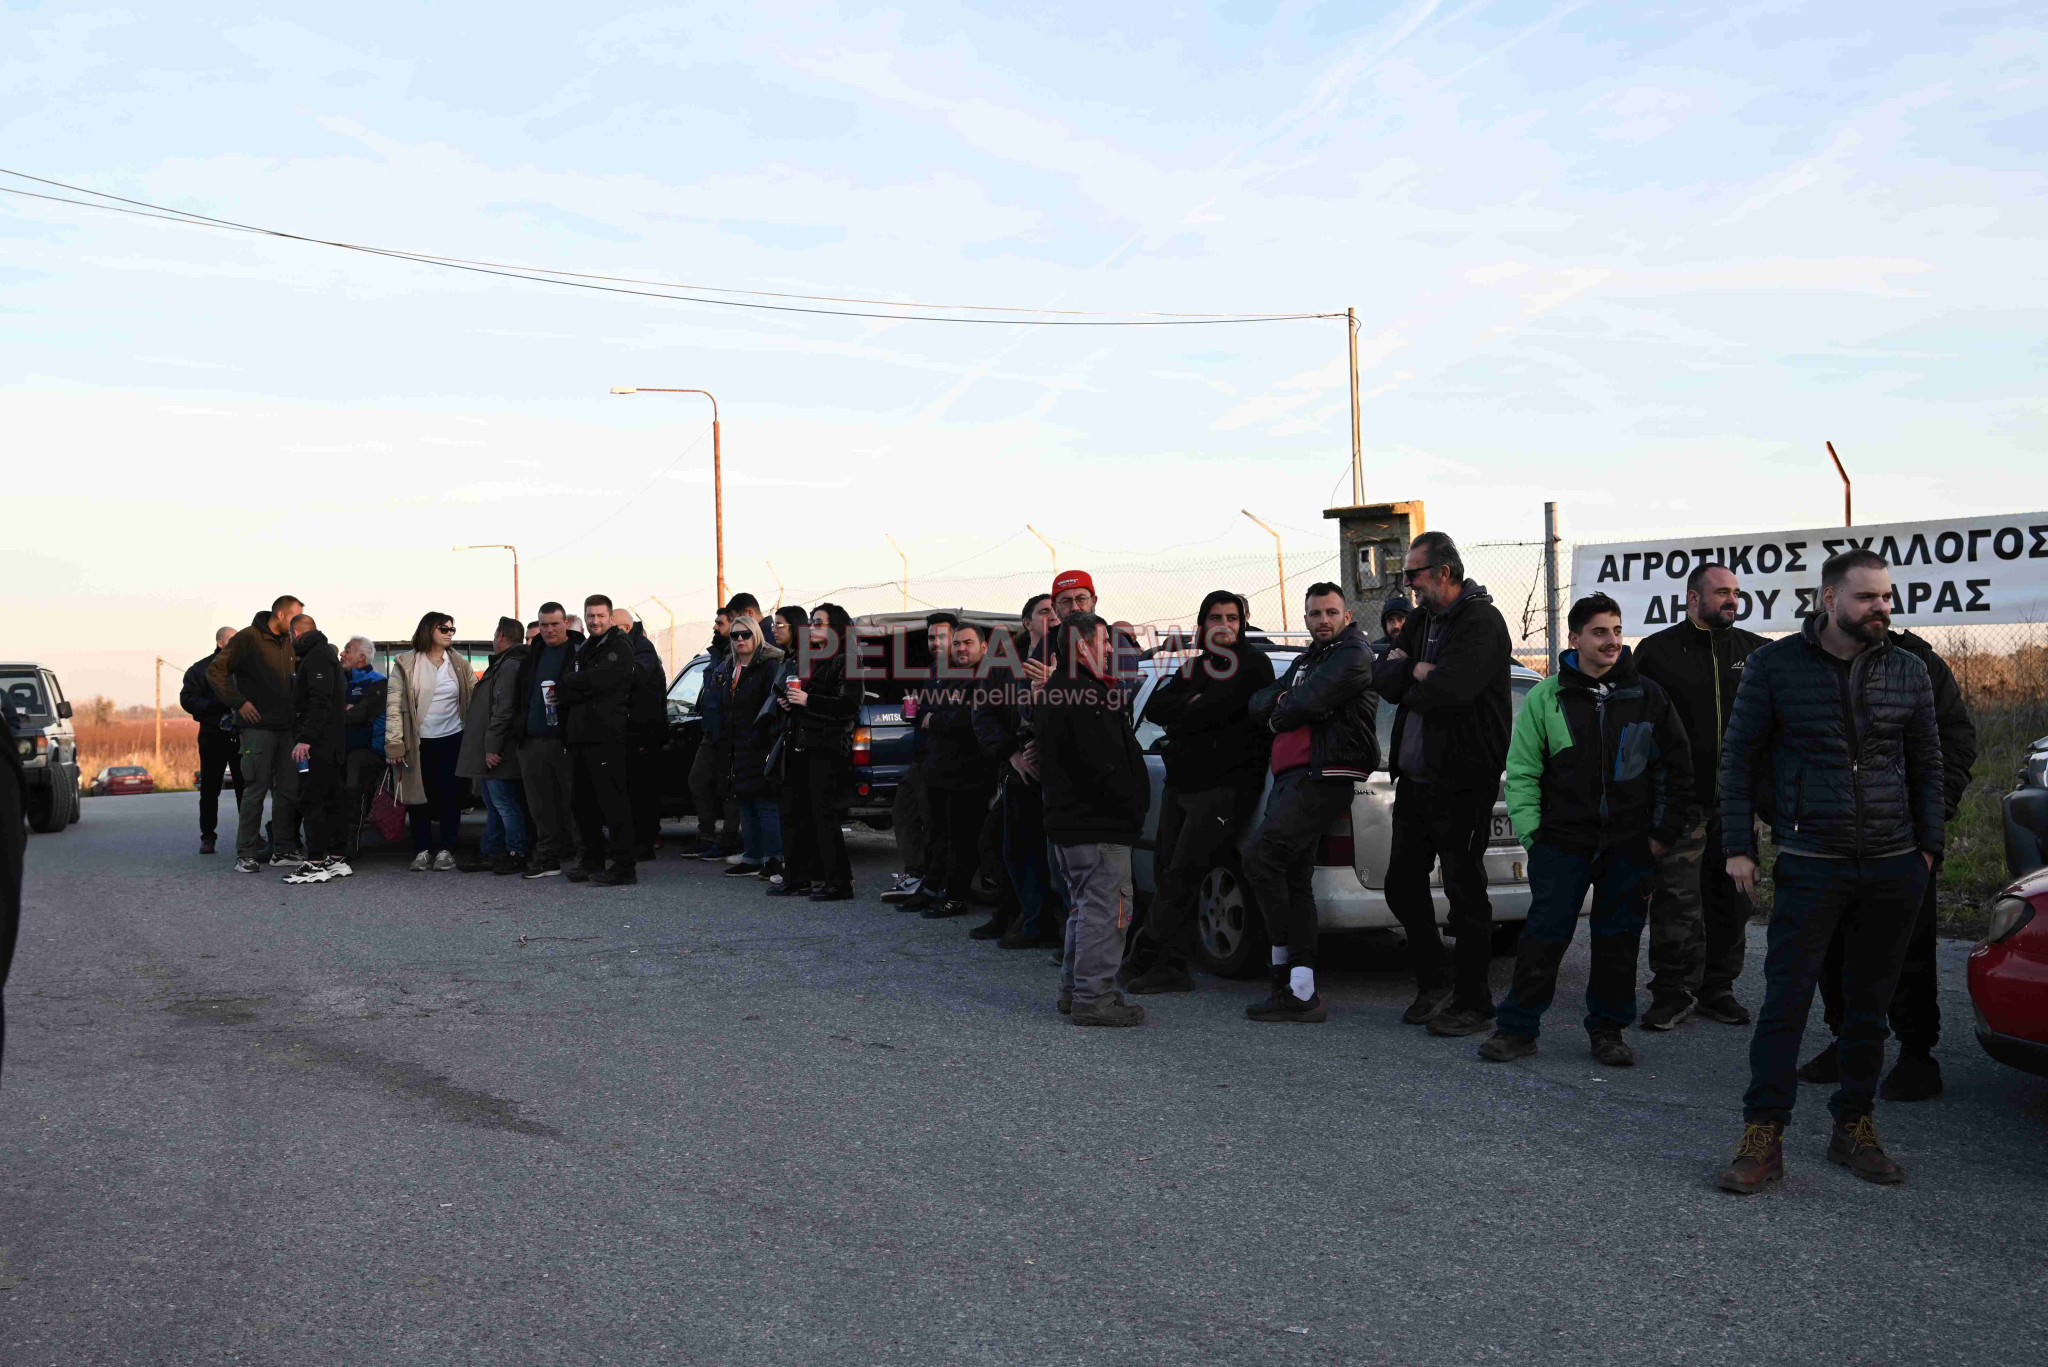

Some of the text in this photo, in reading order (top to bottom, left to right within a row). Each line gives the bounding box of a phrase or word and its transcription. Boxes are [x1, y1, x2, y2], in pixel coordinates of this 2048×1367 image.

[1597, 541, 1807, 583] ΑΓΡΟΤΙΚΟΣ
[1644, 578, 1991, 624] ΔΗΟΥ ΣΔΡΑΣ
